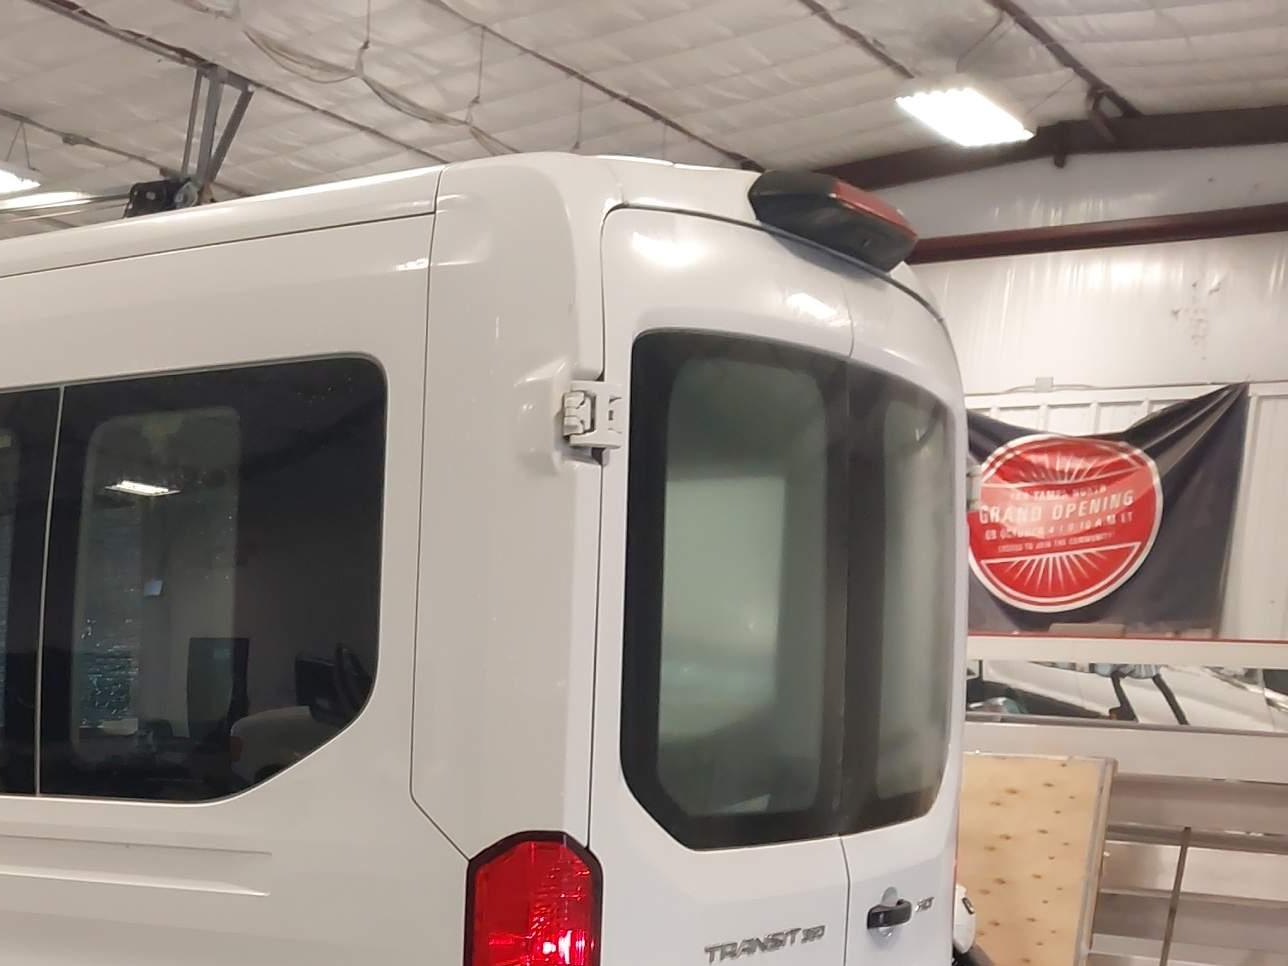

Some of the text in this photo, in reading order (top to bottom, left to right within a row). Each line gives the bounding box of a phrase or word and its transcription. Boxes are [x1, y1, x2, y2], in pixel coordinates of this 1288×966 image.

[979, 505, 1043, 524] GRAND
[1052, 490, 1134, 520] OPENING
[705, 927, 802, 964] TRANSIT
